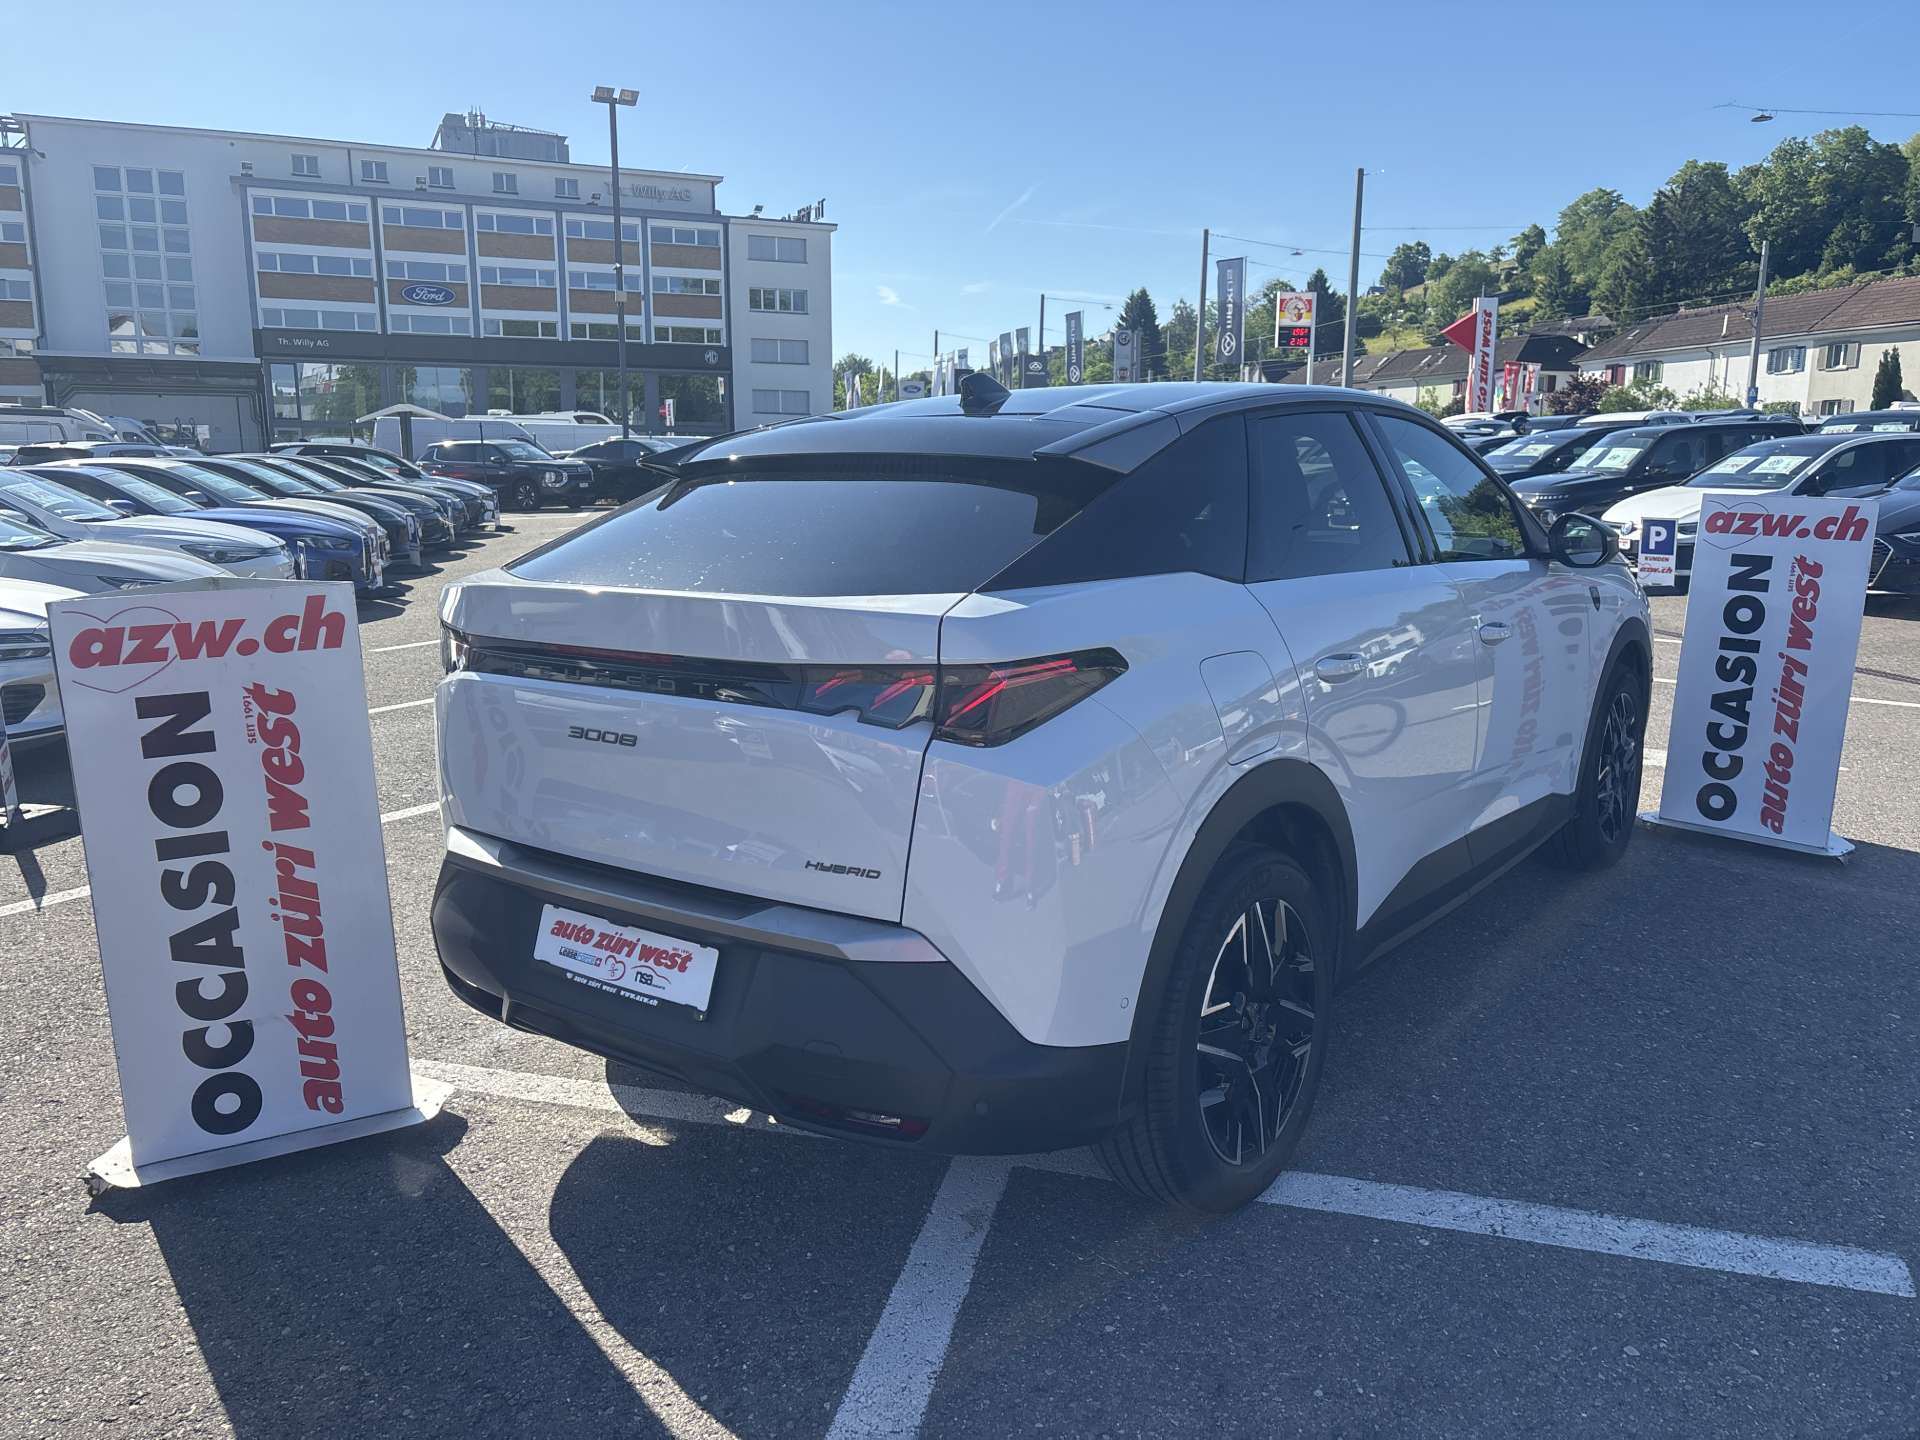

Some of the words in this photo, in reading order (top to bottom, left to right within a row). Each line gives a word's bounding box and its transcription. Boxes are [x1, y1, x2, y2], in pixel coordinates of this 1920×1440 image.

[412, 286, 447, 302] Ford
[278, 337, 292, 346] Th.
[293, 338, 315, 349] Willy
[316, 339, 330, 348] AG
[1482, 309, 1493, 348] west
[1649, 525, 1668, 550] P
[1705, 506, 1869, 541] azw.ch
[69, 595, 346, 669] azw.ch
[1786, 554, 1824, 651] west
[1696, 553, 1774, 821] OCCASION
[1772, 652, 1809, 744] züri
[242, 682, 311, 831] west
[246, 723, 257, 744] SEIT
[568, 725, 637, 747] 3008
[1760, 741, 1795, 835] auto
[804, 859, 881, 879] HYBRID
[135, 691, 263, 1135] OCCASION
[262, 840, 328, 974] züri
[550, 919, 595, 945] auto
[592, 931, 641, 958] züri
[638, 943, 693, 973] west
[284, 978, 344, 1114] auto
